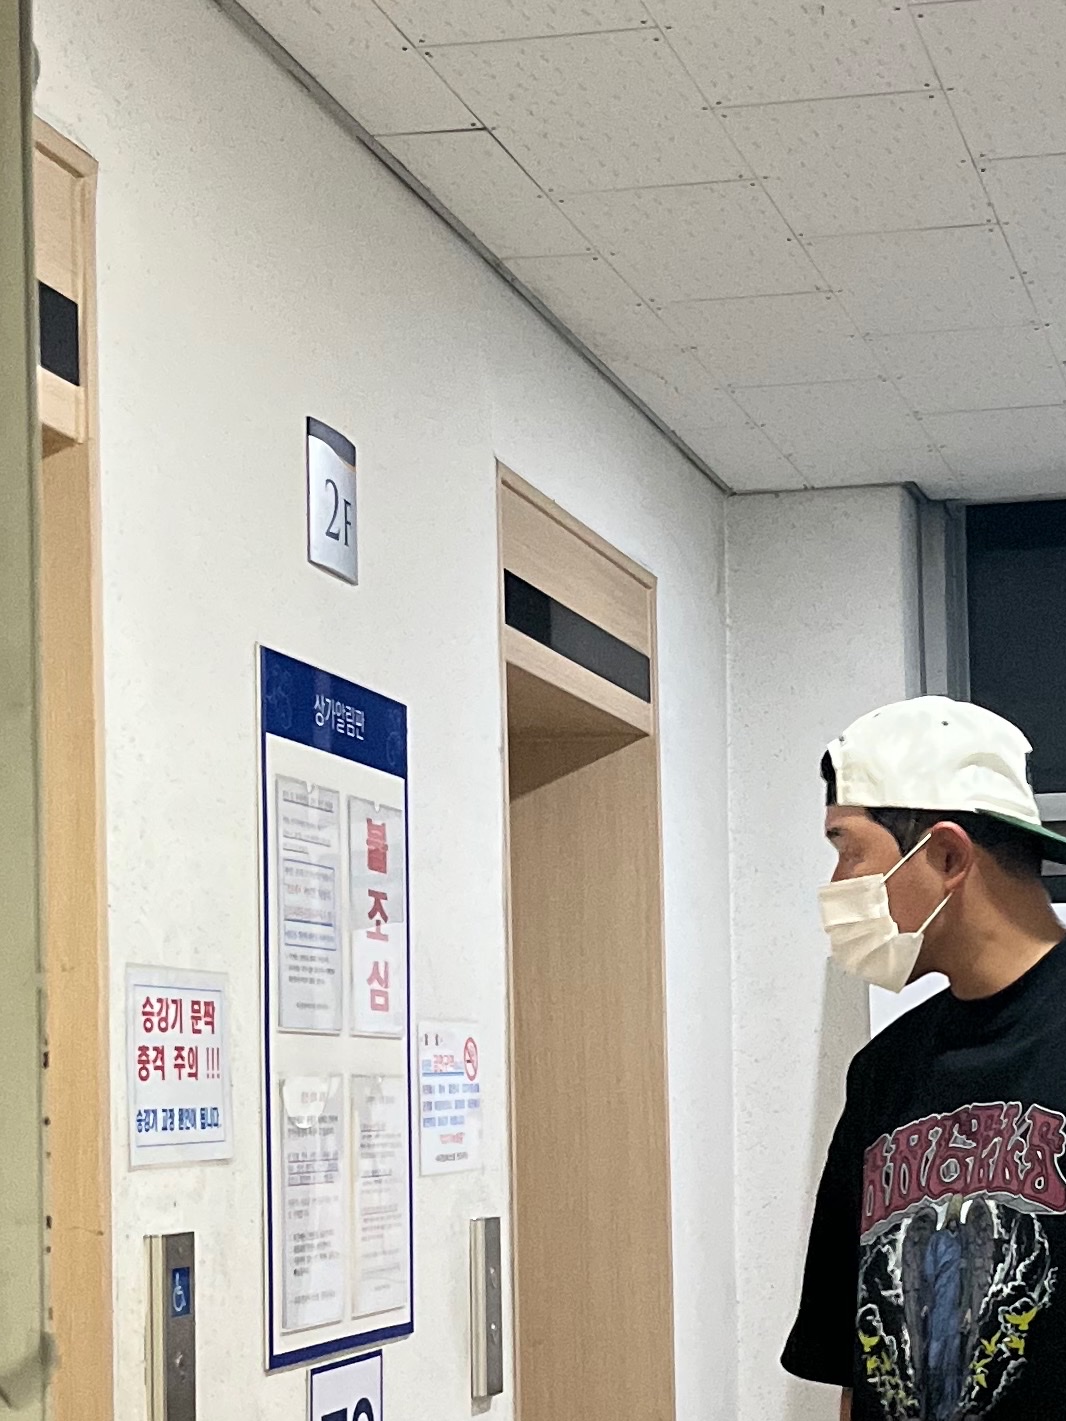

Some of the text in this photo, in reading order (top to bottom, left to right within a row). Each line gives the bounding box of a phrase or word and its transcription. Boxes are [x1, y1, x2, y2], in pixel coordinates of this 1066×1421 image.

[325, 478, 351, 548] 2F
[313, 693, 365, 741] 상가알림판
[142, 996, 215, 1035] 승강기 문짝
[138, 1045, 220, 1082] 충격 주의 !!!
[136, 1108, 158, 1133] 승강기
[161, 1108, 175, 1131] 고장
